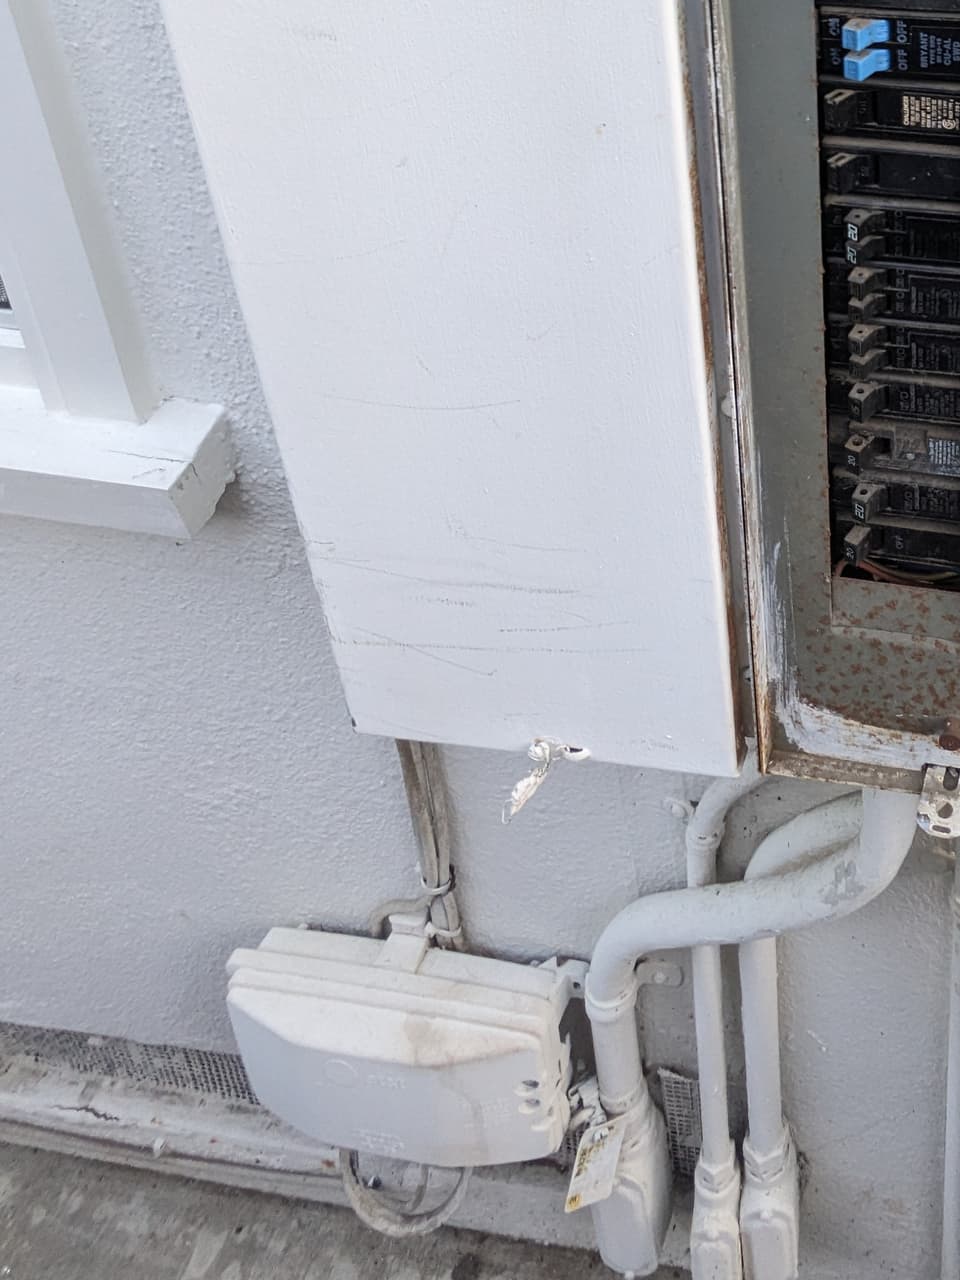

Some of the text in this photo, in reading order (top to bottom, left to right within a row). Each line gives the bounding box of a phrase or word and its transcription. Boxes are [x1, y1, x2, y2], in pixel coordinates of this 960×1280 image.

[896, 19, 908, 43] OFF
[897, 49, 908, 71] OFF
[919, 32, 928, 68] BRYANT
[944, 37, 952, 66] CU-AL
[848, 223, 858, 241] 20
[855, 503, 865, 519] 20
